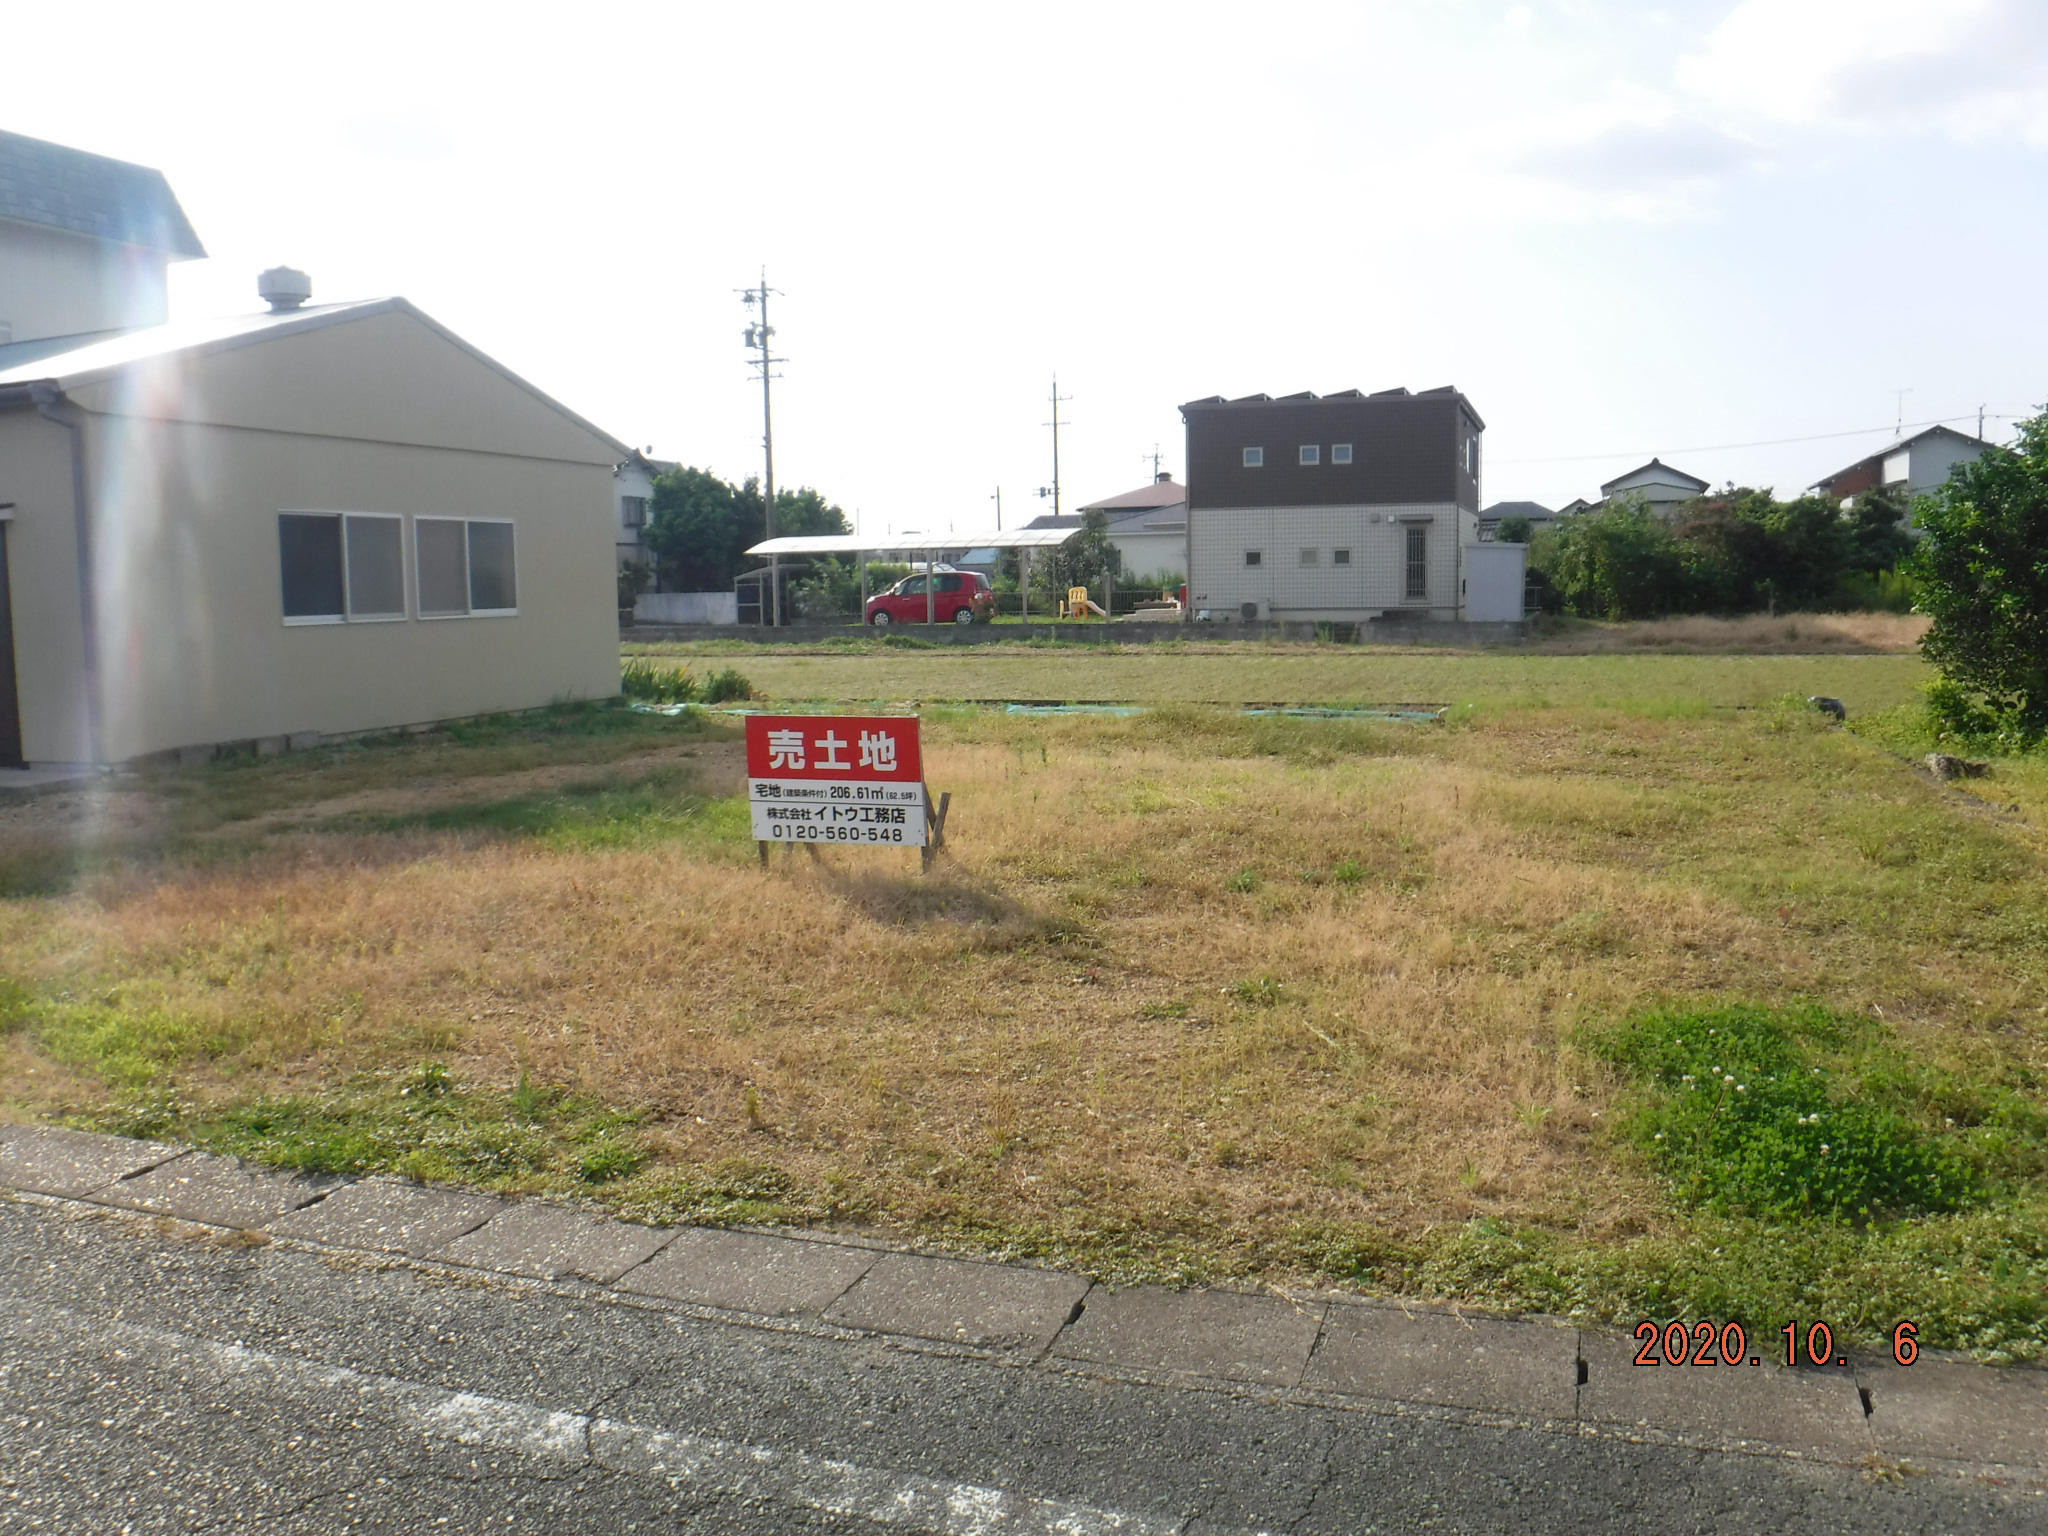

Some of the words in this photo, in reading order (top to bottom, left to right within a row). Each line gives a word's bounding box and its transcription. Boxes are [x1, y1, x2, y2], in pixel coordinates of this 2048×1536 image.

[767, 729, 898, 772] 売土地
[767, 806, 906, 824] 株式会社イトウ工務店
[772, 824, 903, 842] 0120-560-548
